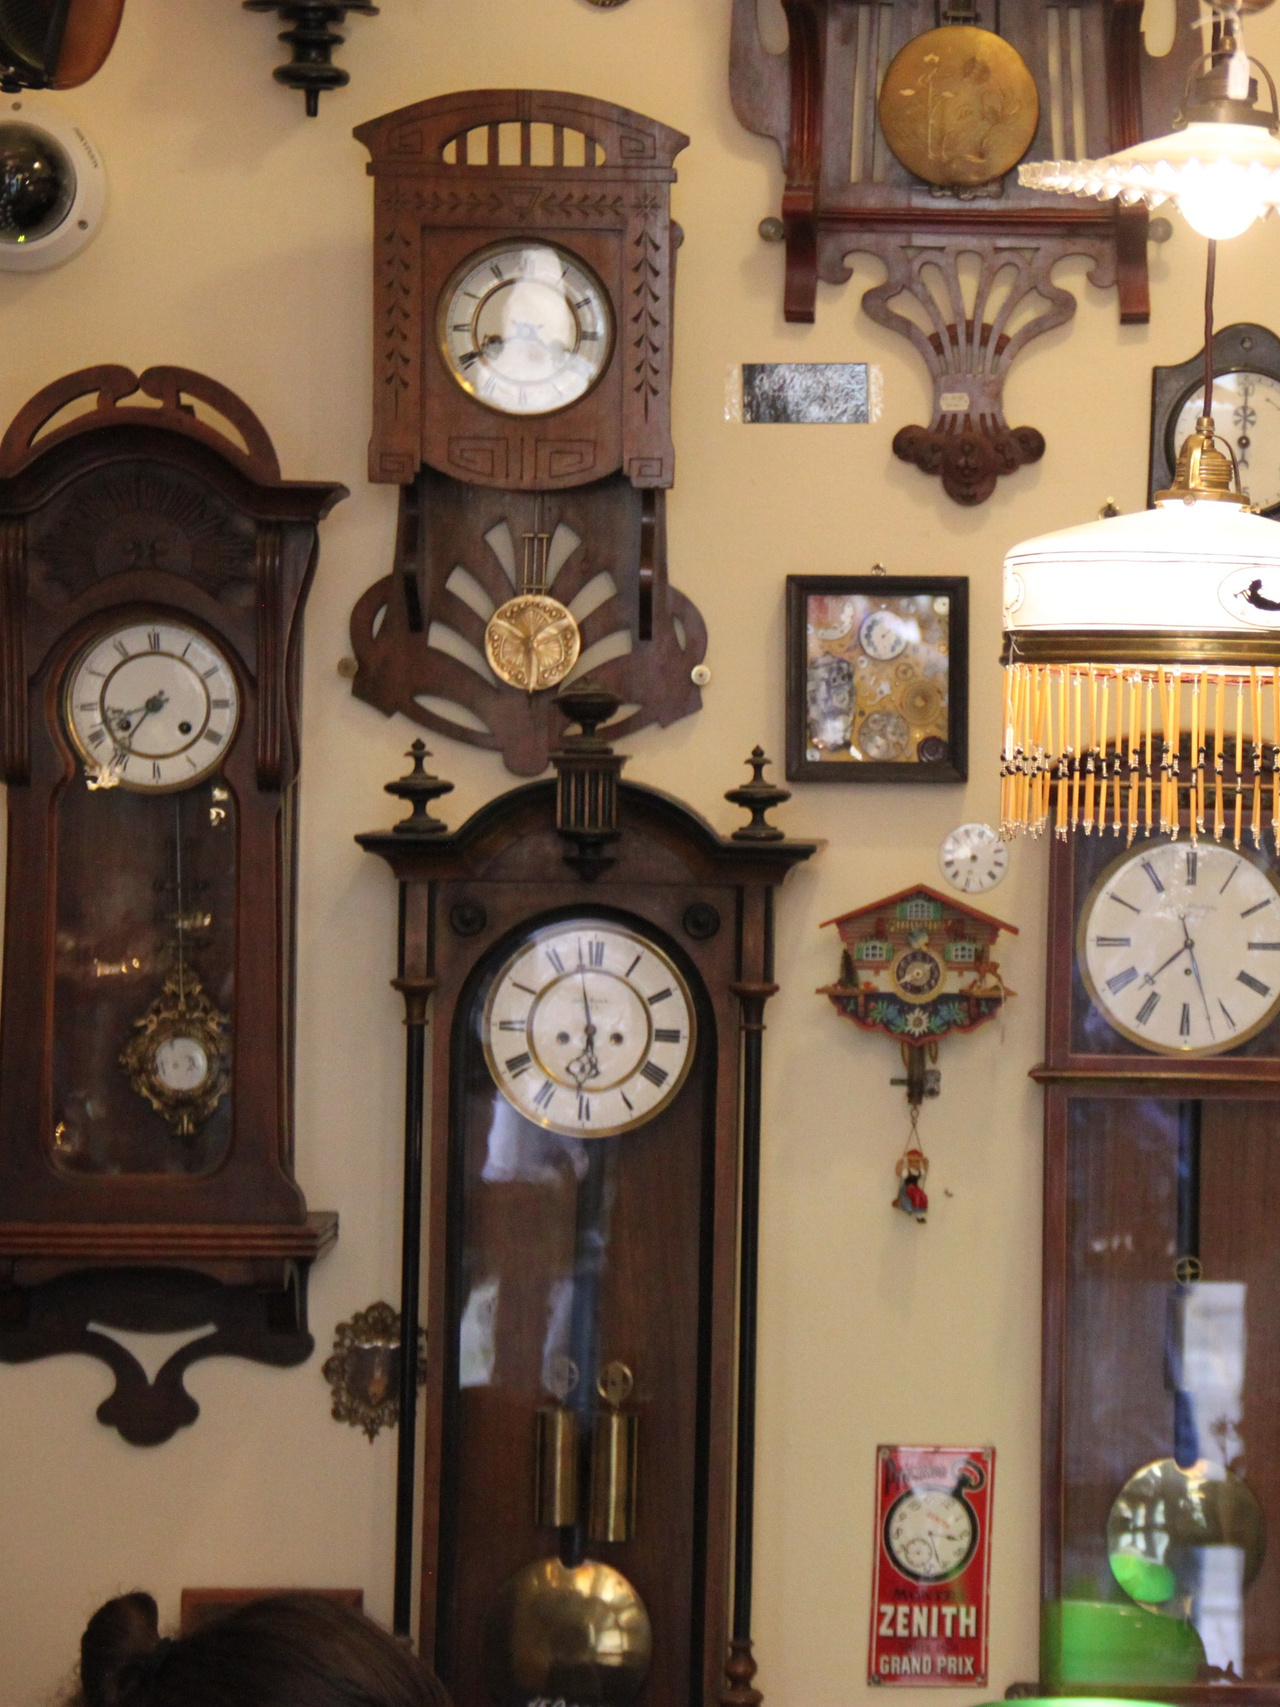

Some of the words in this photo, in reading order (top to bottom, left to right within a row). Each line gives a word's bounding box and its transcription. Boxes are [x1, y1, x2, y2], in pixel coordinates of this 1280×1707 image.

[879, 1605, 977, 1637] ZENITH
[880, 1655, 932, 1675] GRAND
[937, 1656, 974, 1675] PRIX
